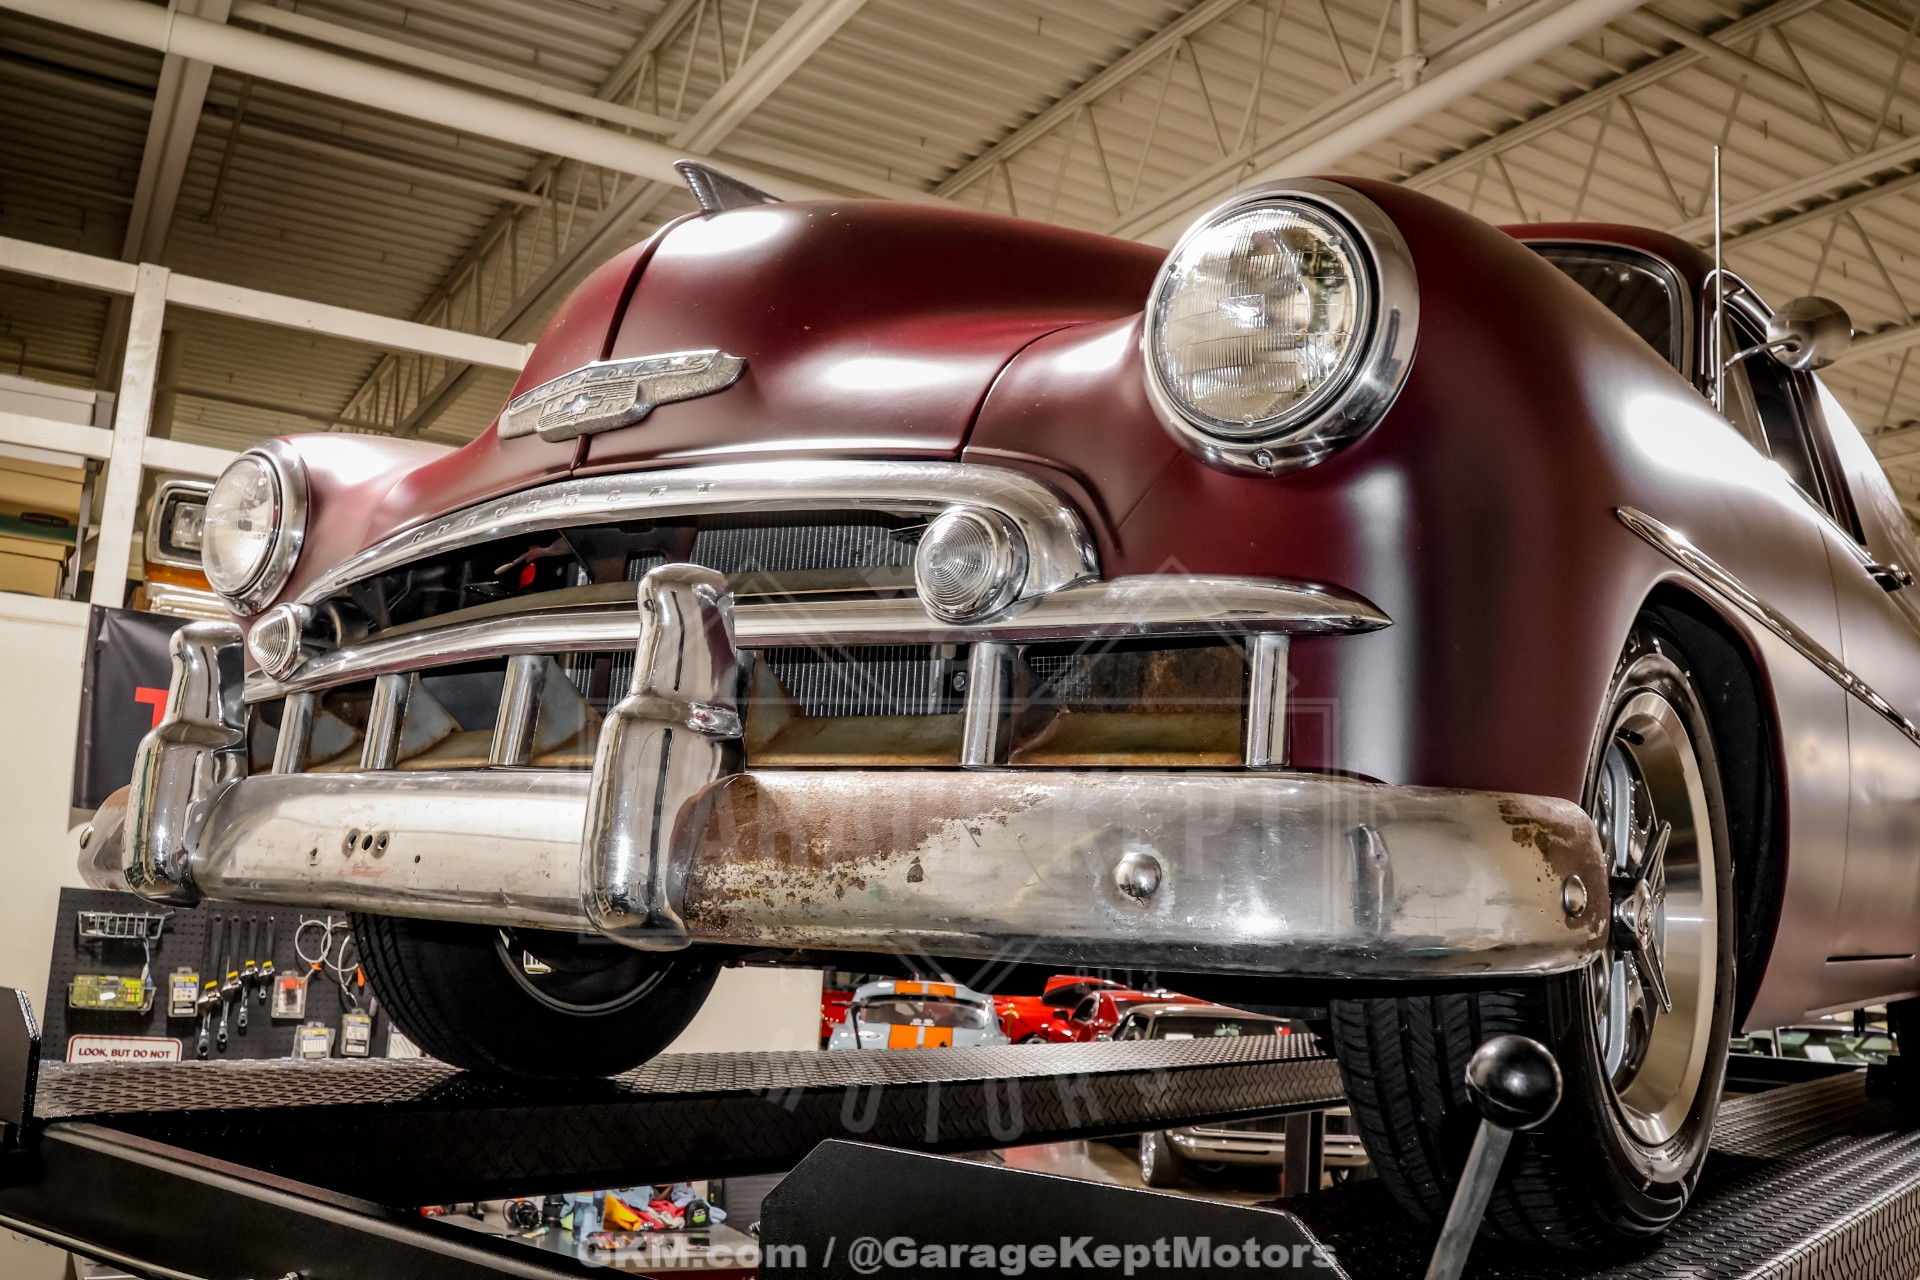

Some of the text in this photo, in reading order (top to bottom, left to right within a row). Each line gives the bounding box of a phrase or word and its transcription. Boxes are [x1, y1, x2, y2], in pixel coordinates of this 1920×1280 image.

[78, 1047, 171, 1059] LOOK, BUT DO NOT
